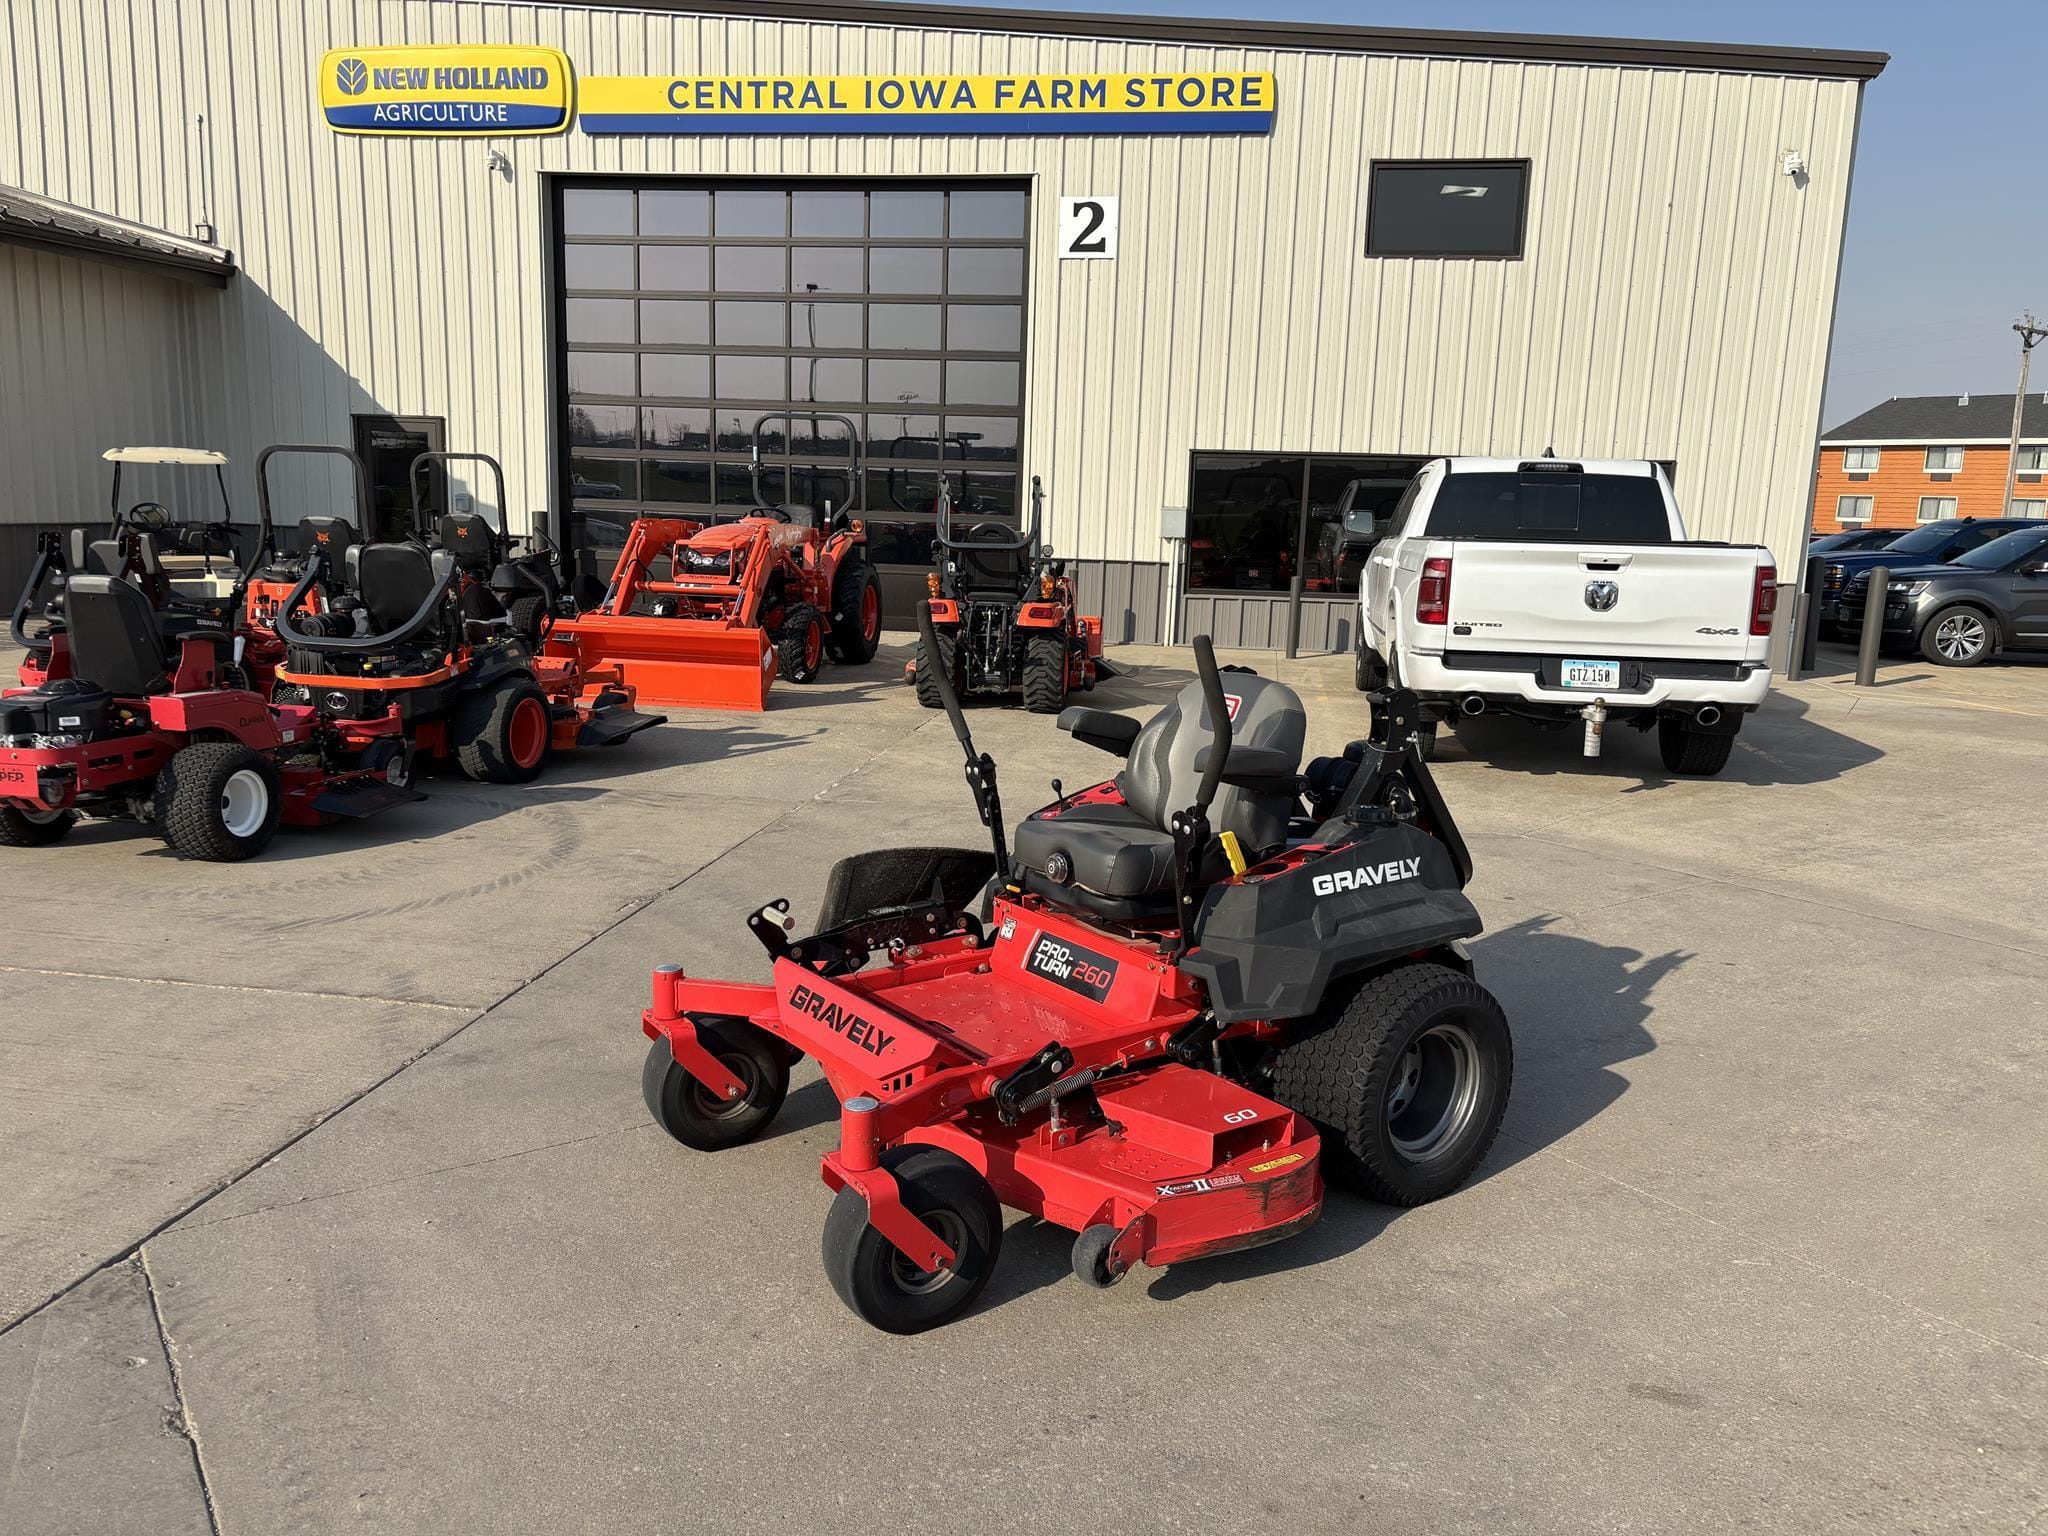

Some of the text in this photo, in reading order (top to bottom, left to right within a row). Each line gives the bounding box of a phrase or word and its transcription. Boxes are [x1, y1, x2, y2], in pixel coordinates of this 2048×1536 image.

[373, 66, 549, 90] NEW HOLLAND
[667, 76, 1263, 109] CENTRAL IOWA FARM STORE
[373, 103, 508, 122] AGRICULTURE
[1069, 201, 1106, 253] 2
[1569, 667, 1611, 683] GTZ 150
[1312, 856, 1421, 897] GRAVELY
[1037, 939, 1074, 961] PRO-
[1033, 952, 1112, 990] TURN 260
[789, 984, 897, 1057] GRAVELY
[1223, 1108, 1258, 1124] 60
